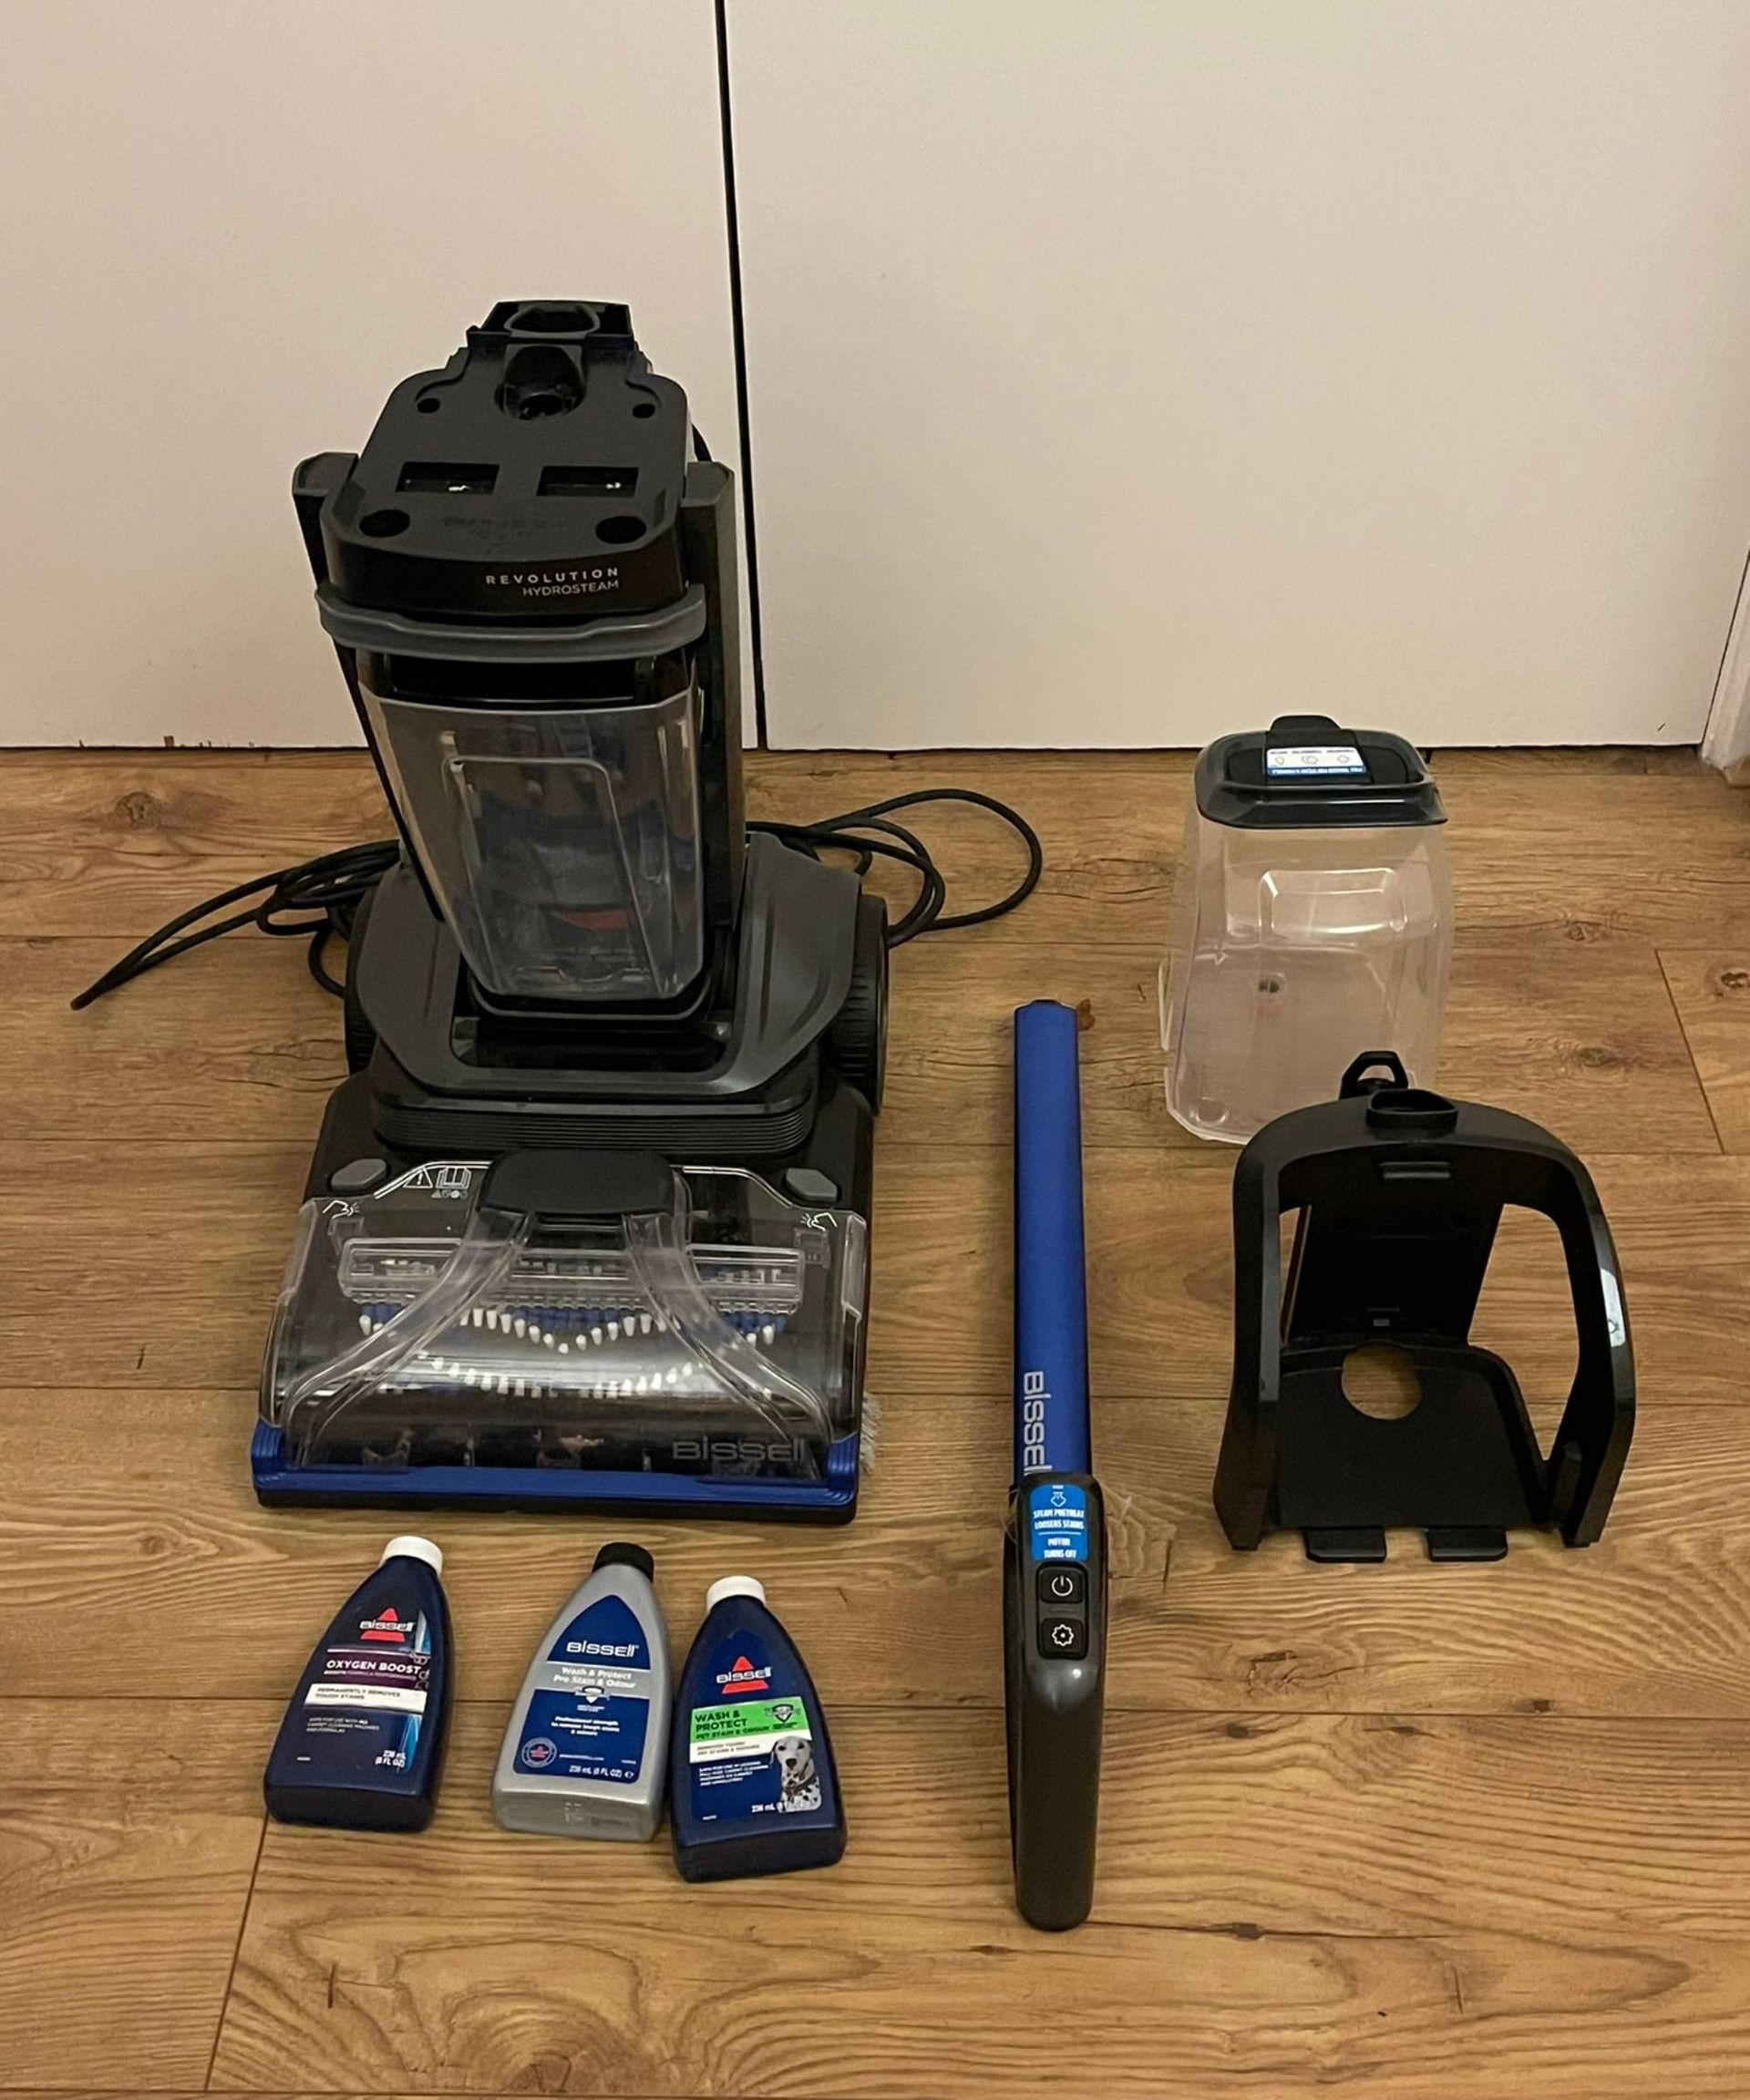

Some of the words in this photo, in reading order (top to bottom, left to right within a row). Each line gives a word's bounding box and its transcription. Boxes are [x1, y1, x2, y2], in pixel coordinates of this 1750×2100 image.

[485, 566, 620, 585] REVOLUTION
[522, 580, 620, 597] HYDROSTEAM
[1024, 1371, 1053, 1477] BISSEL
[325, 1659, 377, 1671] OXYGEN
[378, 1662, 421, 1675] BOOST
[561, 1667, 587, 1676] Wash
[588, 1669, 596, 1677] &
[597, 1669, 633, 1680] Protect
[553, 1674, 570, 1683] Pro
[571, 1675, 596, 1685] Stain
[597, 1678, 604, 1686] &
[695, 1711, 730, 1723] WASH
[733, 1710, 740, 1718] &
[696, 1718, 747, 1733] PROTECT
